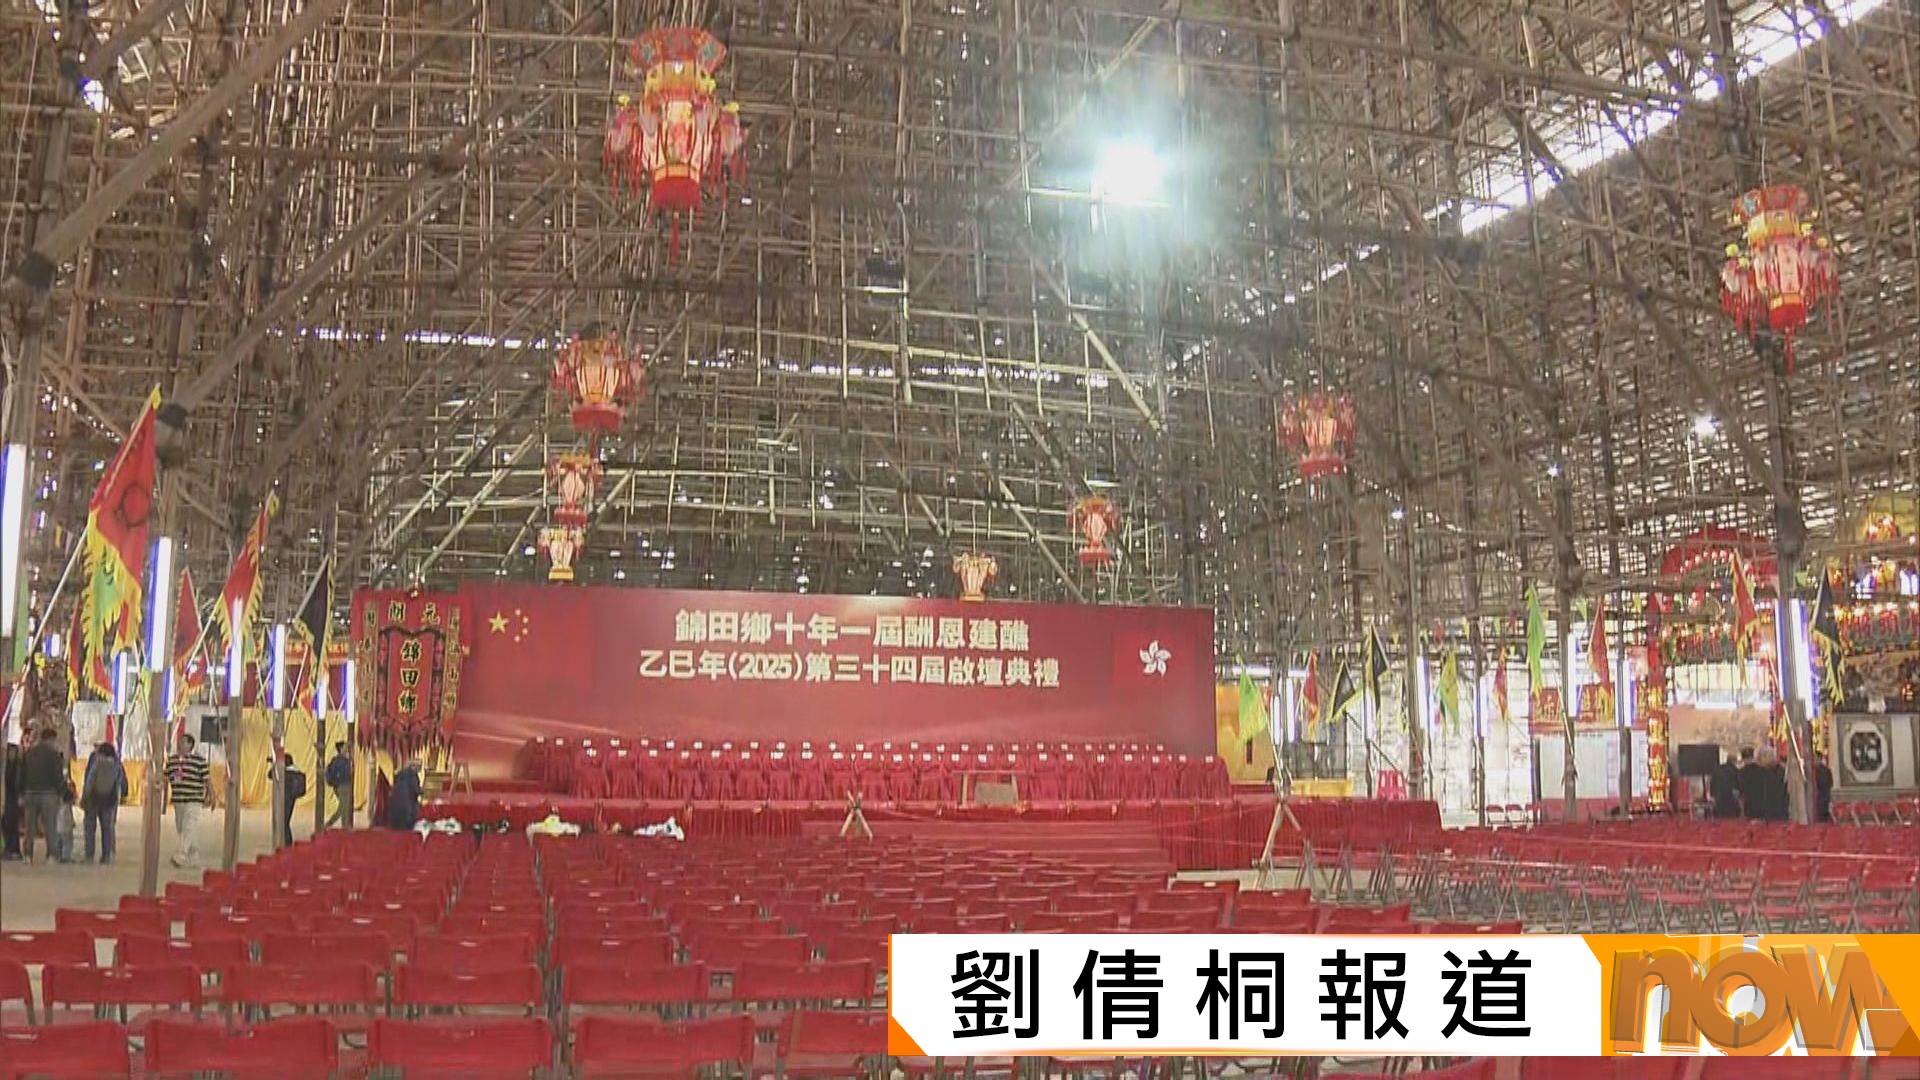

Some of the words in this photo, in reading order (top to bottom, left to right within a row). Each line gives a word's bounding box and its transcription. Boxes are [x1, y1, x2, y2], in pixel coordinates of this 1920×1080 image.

[675, 608, 1029, 651] 錦田鄉十年一屆酬恩建醮
